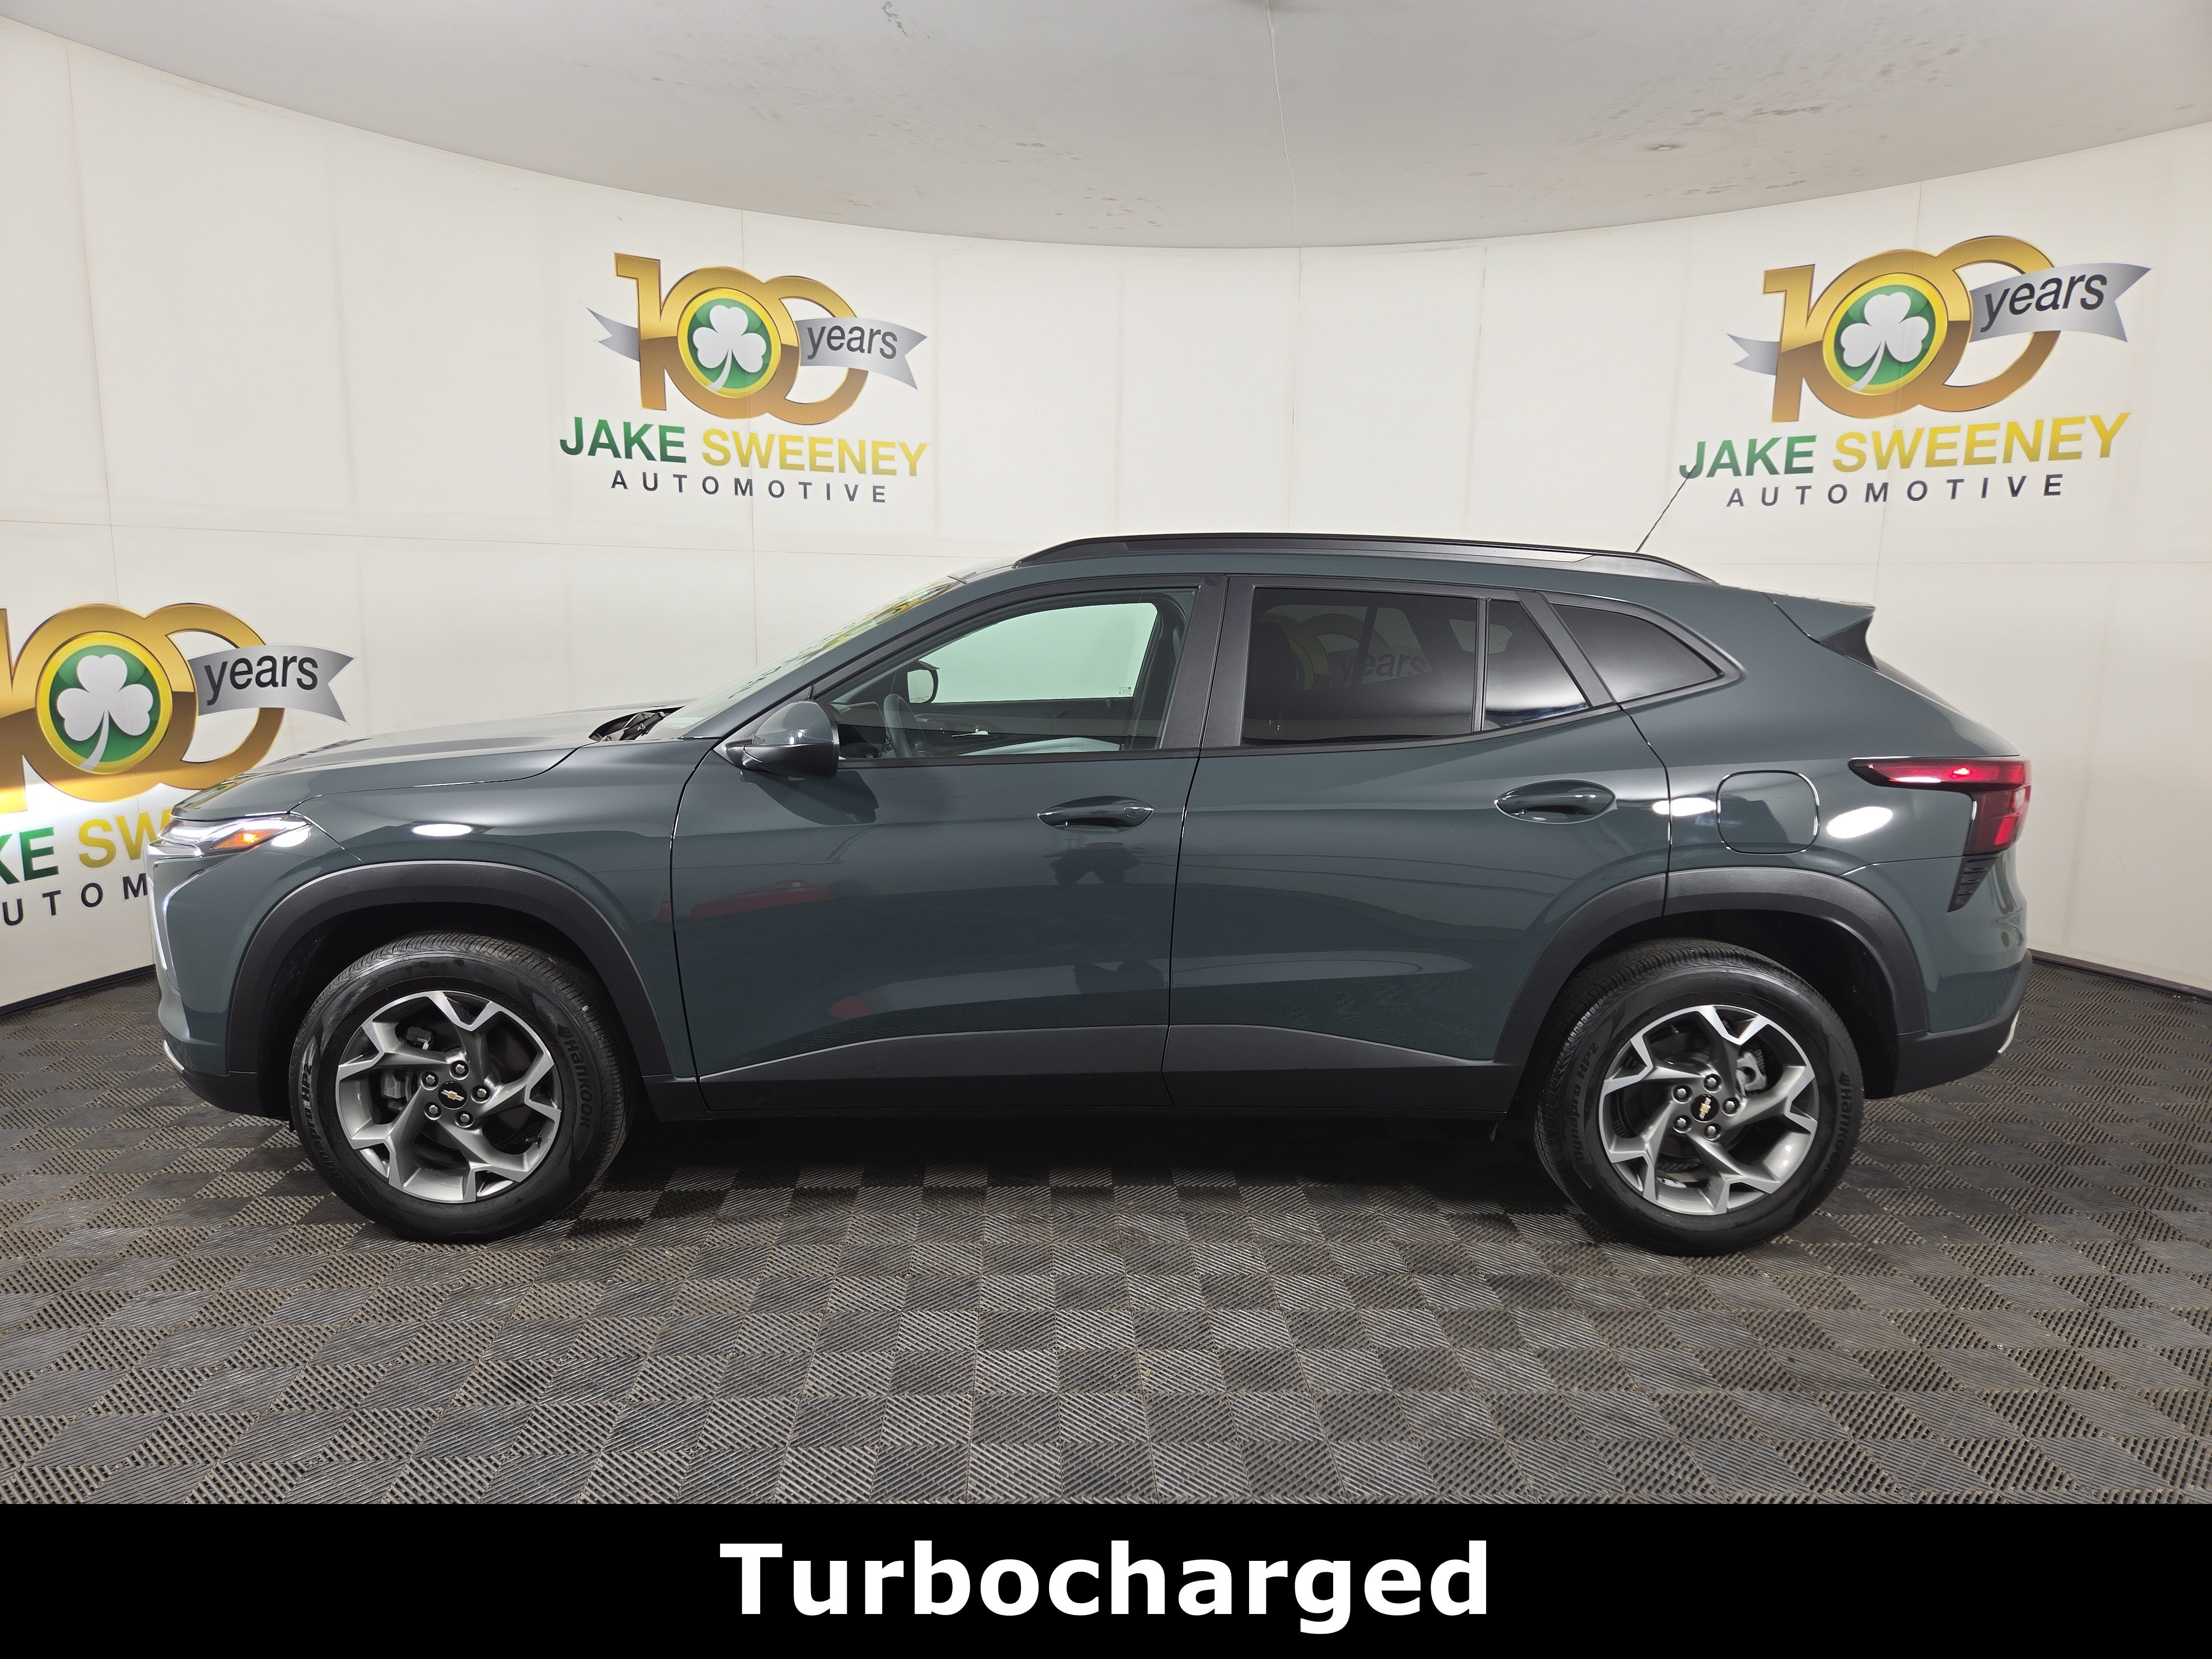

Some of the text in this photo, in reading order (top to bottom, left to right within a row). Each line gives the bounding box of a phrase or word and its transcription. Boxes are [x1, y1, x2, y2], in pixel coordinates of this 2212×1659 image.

[1763, 235, 2062, 423] 100
[1979, 273, 2107, 333] years
[614, 253, 869, 426] 100
[806, 325, 898, 360] years
[560, 416, 928, 477] JAKE SWEENEY
[1679, 411, 2131, 479] JAKE SWEENEY
[611, 470, 886, 503] AUTOMOTIVE
[1726, 473, 2064, 508] AUTOMOTIVE
[204, 654, 319, 706] years
[1576, 1041, 1599, 1079] HP2
